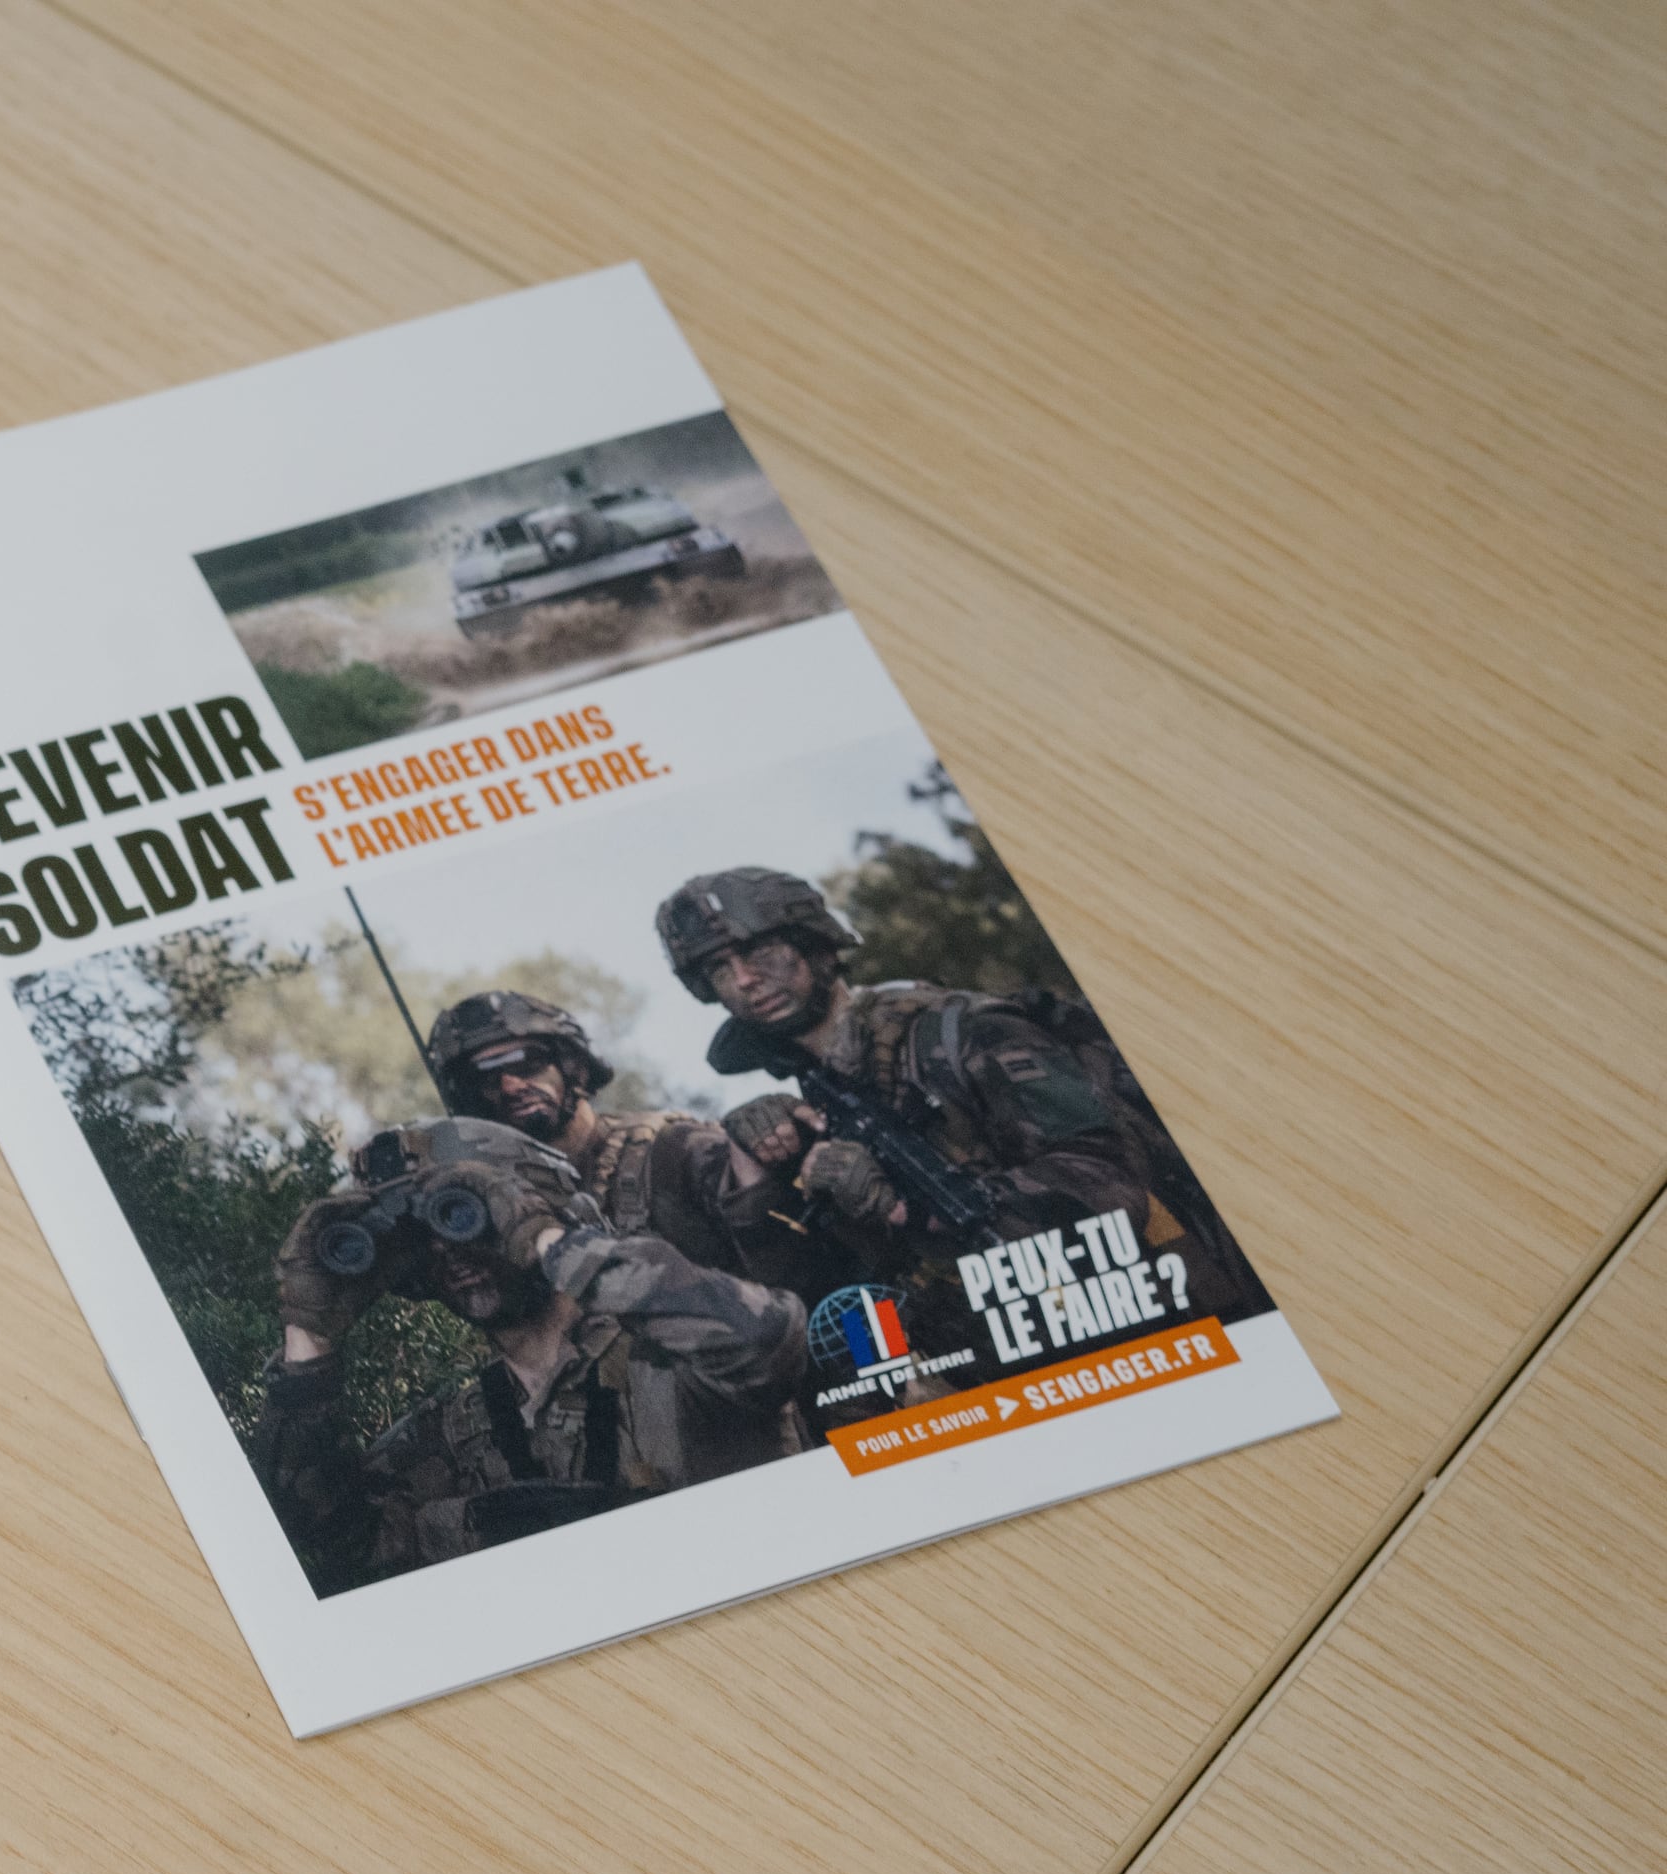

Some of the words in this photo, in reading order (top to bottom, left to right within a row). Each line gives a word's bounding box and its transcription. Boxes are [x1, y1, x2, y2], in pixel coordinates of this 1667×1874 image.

[293, 735, 508, 822] S'ENGAGER
[505, 704, 615, 763] DANS
[478, 778, 537, 823] DE
[533, 742, 672, 807] TERRE.
[957, 1208, 1141, 1311] PEUX-TU
[891, 1365, 916, 1384] DE
[918, 1347, 976, 1375] TERRE
[984, 1296, 1044, 1364] LE
[855, 1430, 903, 1457] POUR
[903, 1423, 929, 1443] LE
[928, 1405, 990, 1435] SAVOIR
[1023, 1333, 1219, 1412] SENGAGER.FR
